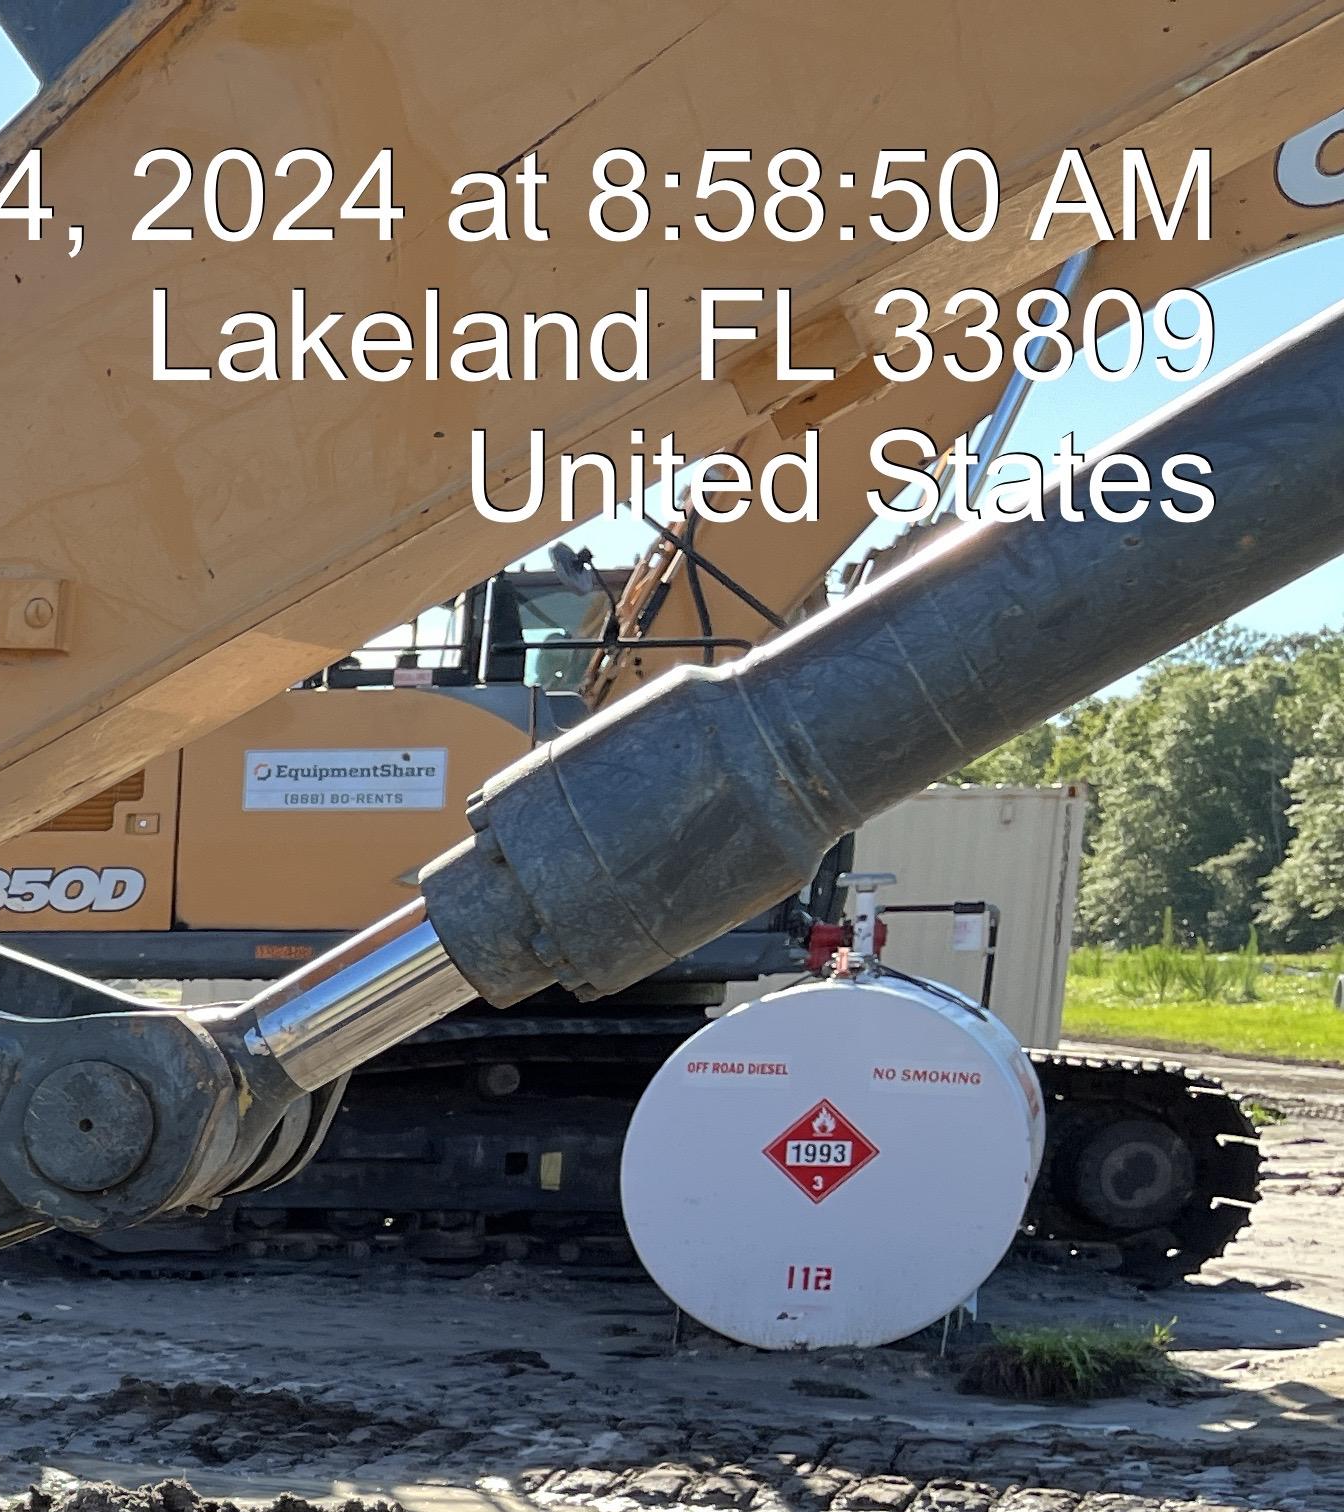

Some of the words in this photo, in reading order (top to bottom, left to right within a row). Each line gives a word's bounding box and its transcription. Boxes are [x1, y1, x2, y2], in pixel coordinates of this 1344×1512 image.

[275, 764, 436, 781] EquipmentShare
[687, 1062, 709, 1073] OFF
[712, 1062, 744, 1074] ROAD
[748, 1063, 788, 1075] DIESEL
[873, 1067, 896, 1080] NO
[901, 1068, 982, 1085] SMOKING
[792, 1143, 846, 1163] 1993
[812, 1175, 823, 1190] 3
[787, 1265, 833, 1291] 112
